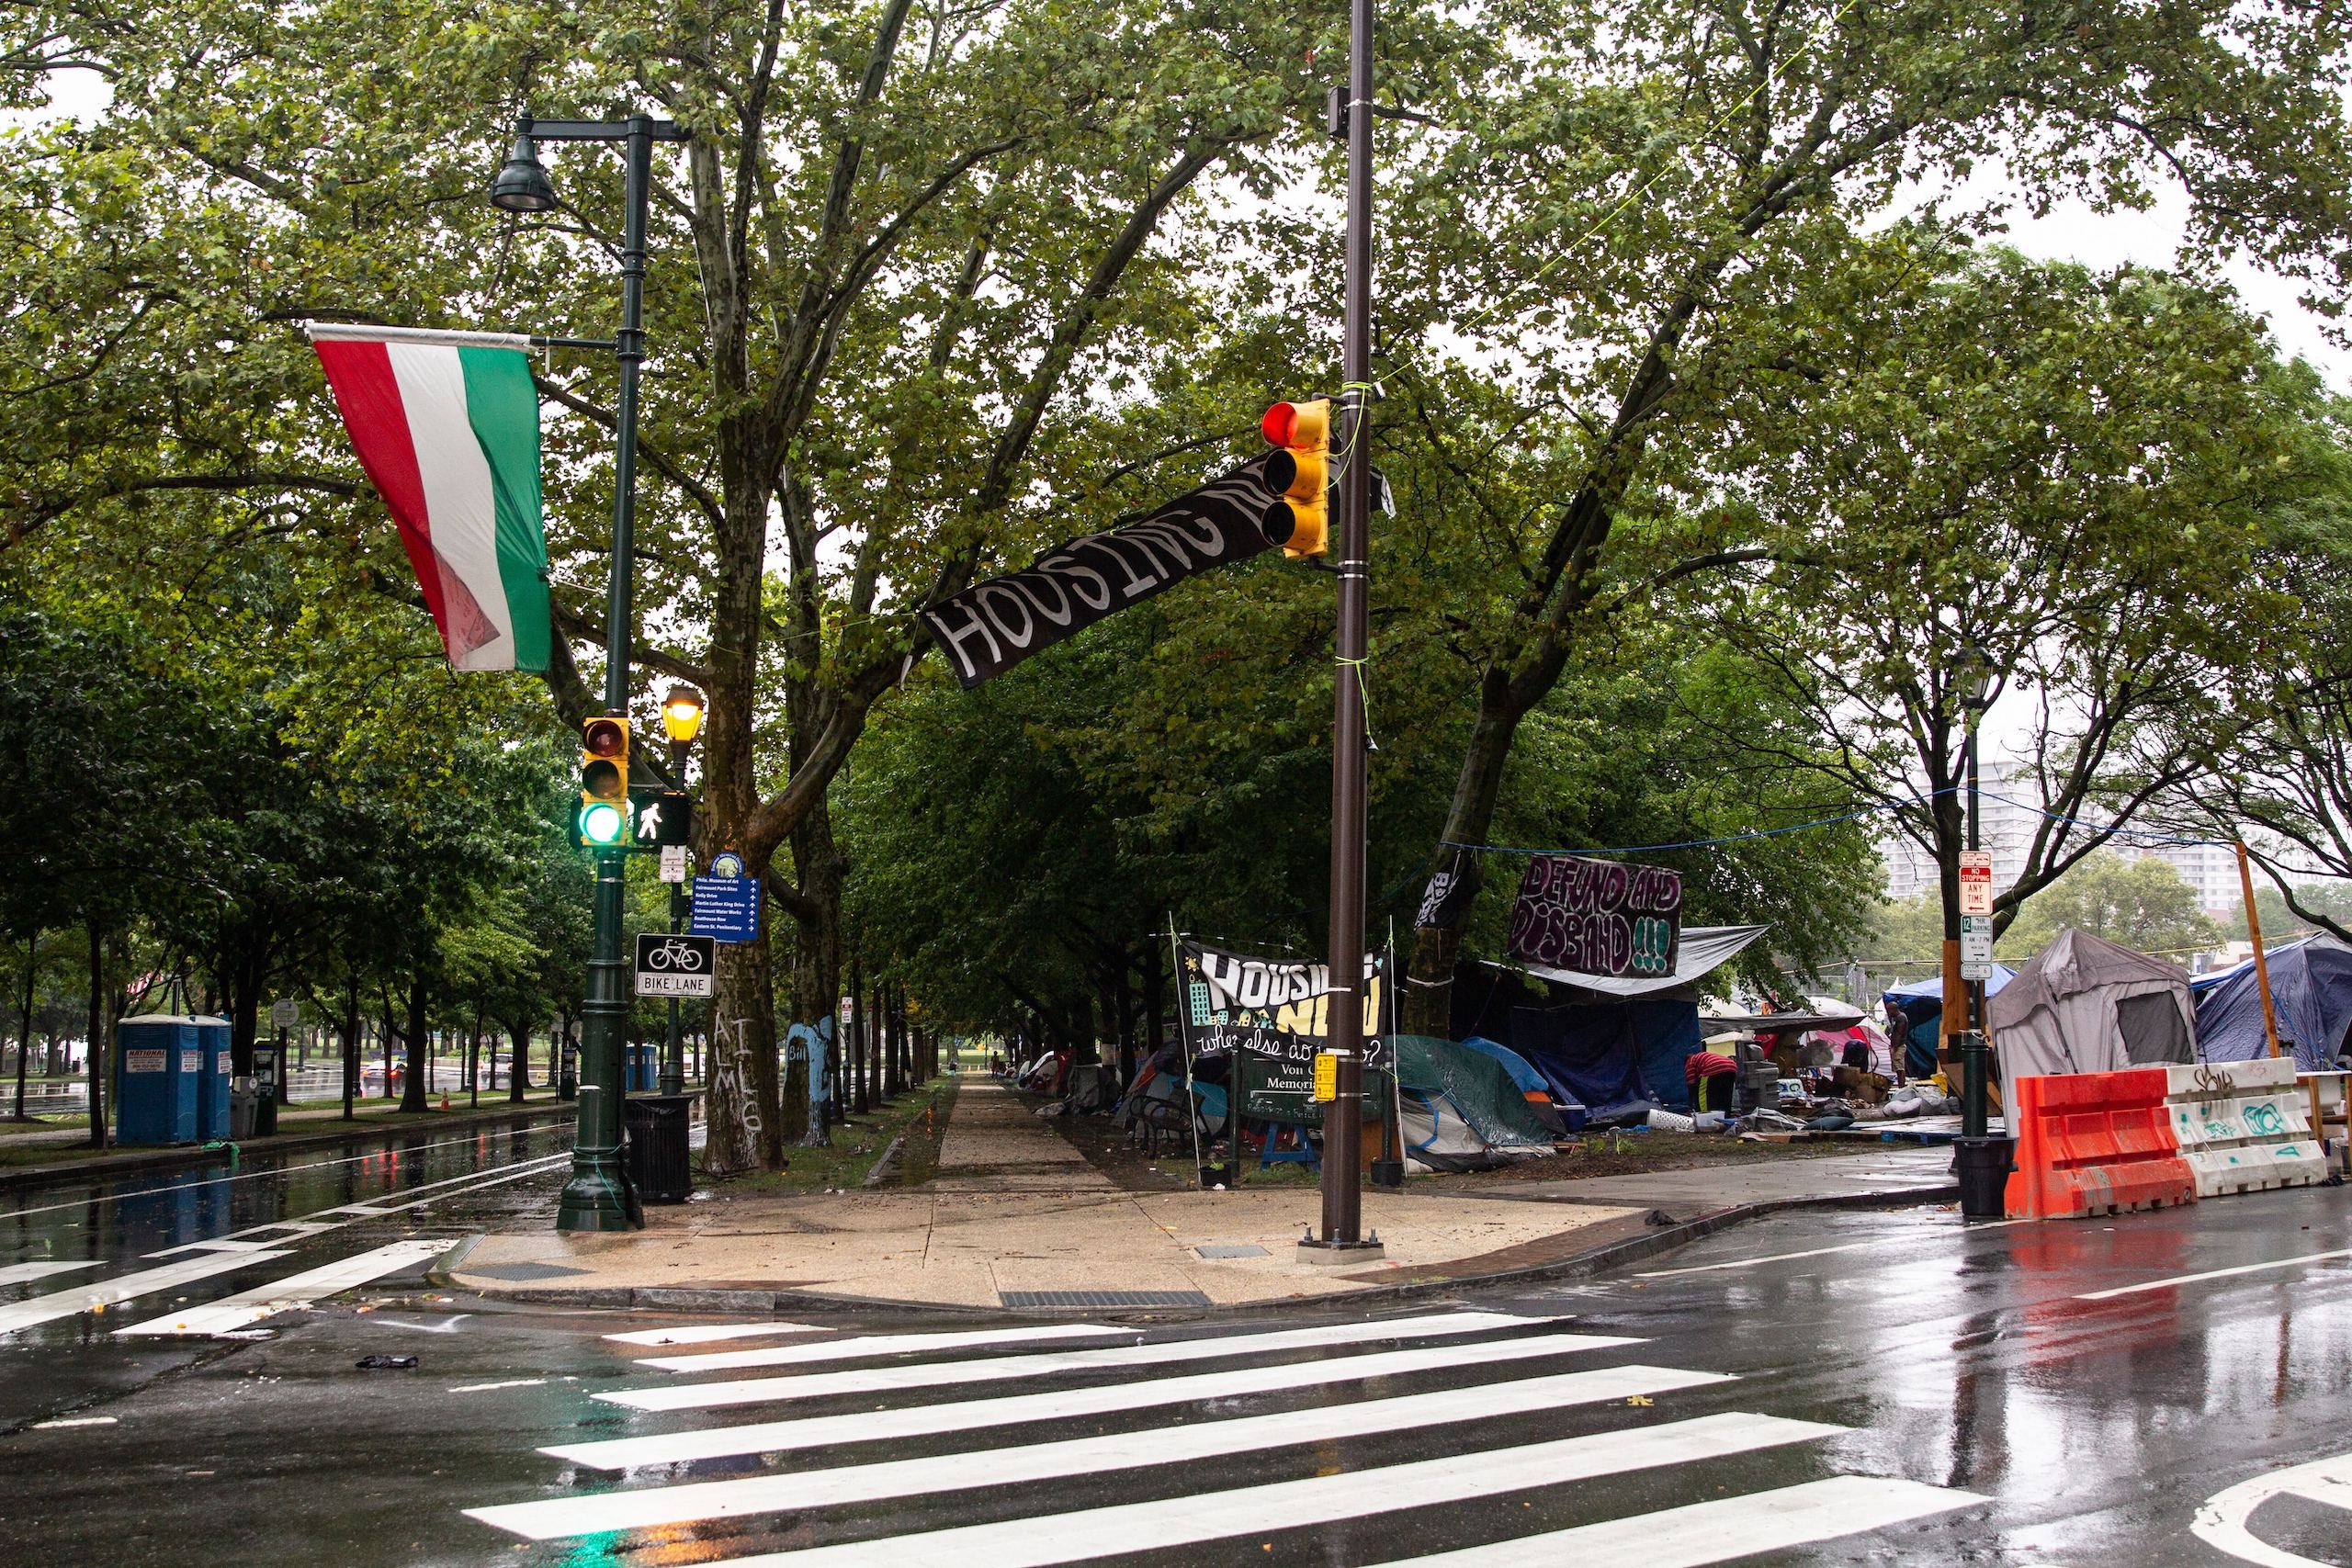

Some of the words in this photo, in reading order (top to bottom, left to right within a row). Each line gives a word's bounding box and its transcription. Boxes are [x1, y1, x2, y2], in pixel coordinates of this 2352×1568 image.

[926, 510, 1225, 678] HOUSING
[1523, 855, 1629, 915] DEFUND
[1629, 865, 1681, 911] AND
[1968, 884, 1983, 892] ANY
[1968, 894, 1984, 903] TIME
[1963, 918, 1971, 931] 12
[644, 977, 670, 989] BIKE
[676, 978, 705, 990] LANE
[1243, 1028, 1282, 1056] else
[1288, 1035, 1312, 1061] do
[1281, 1064, 1304, 1076] Von
